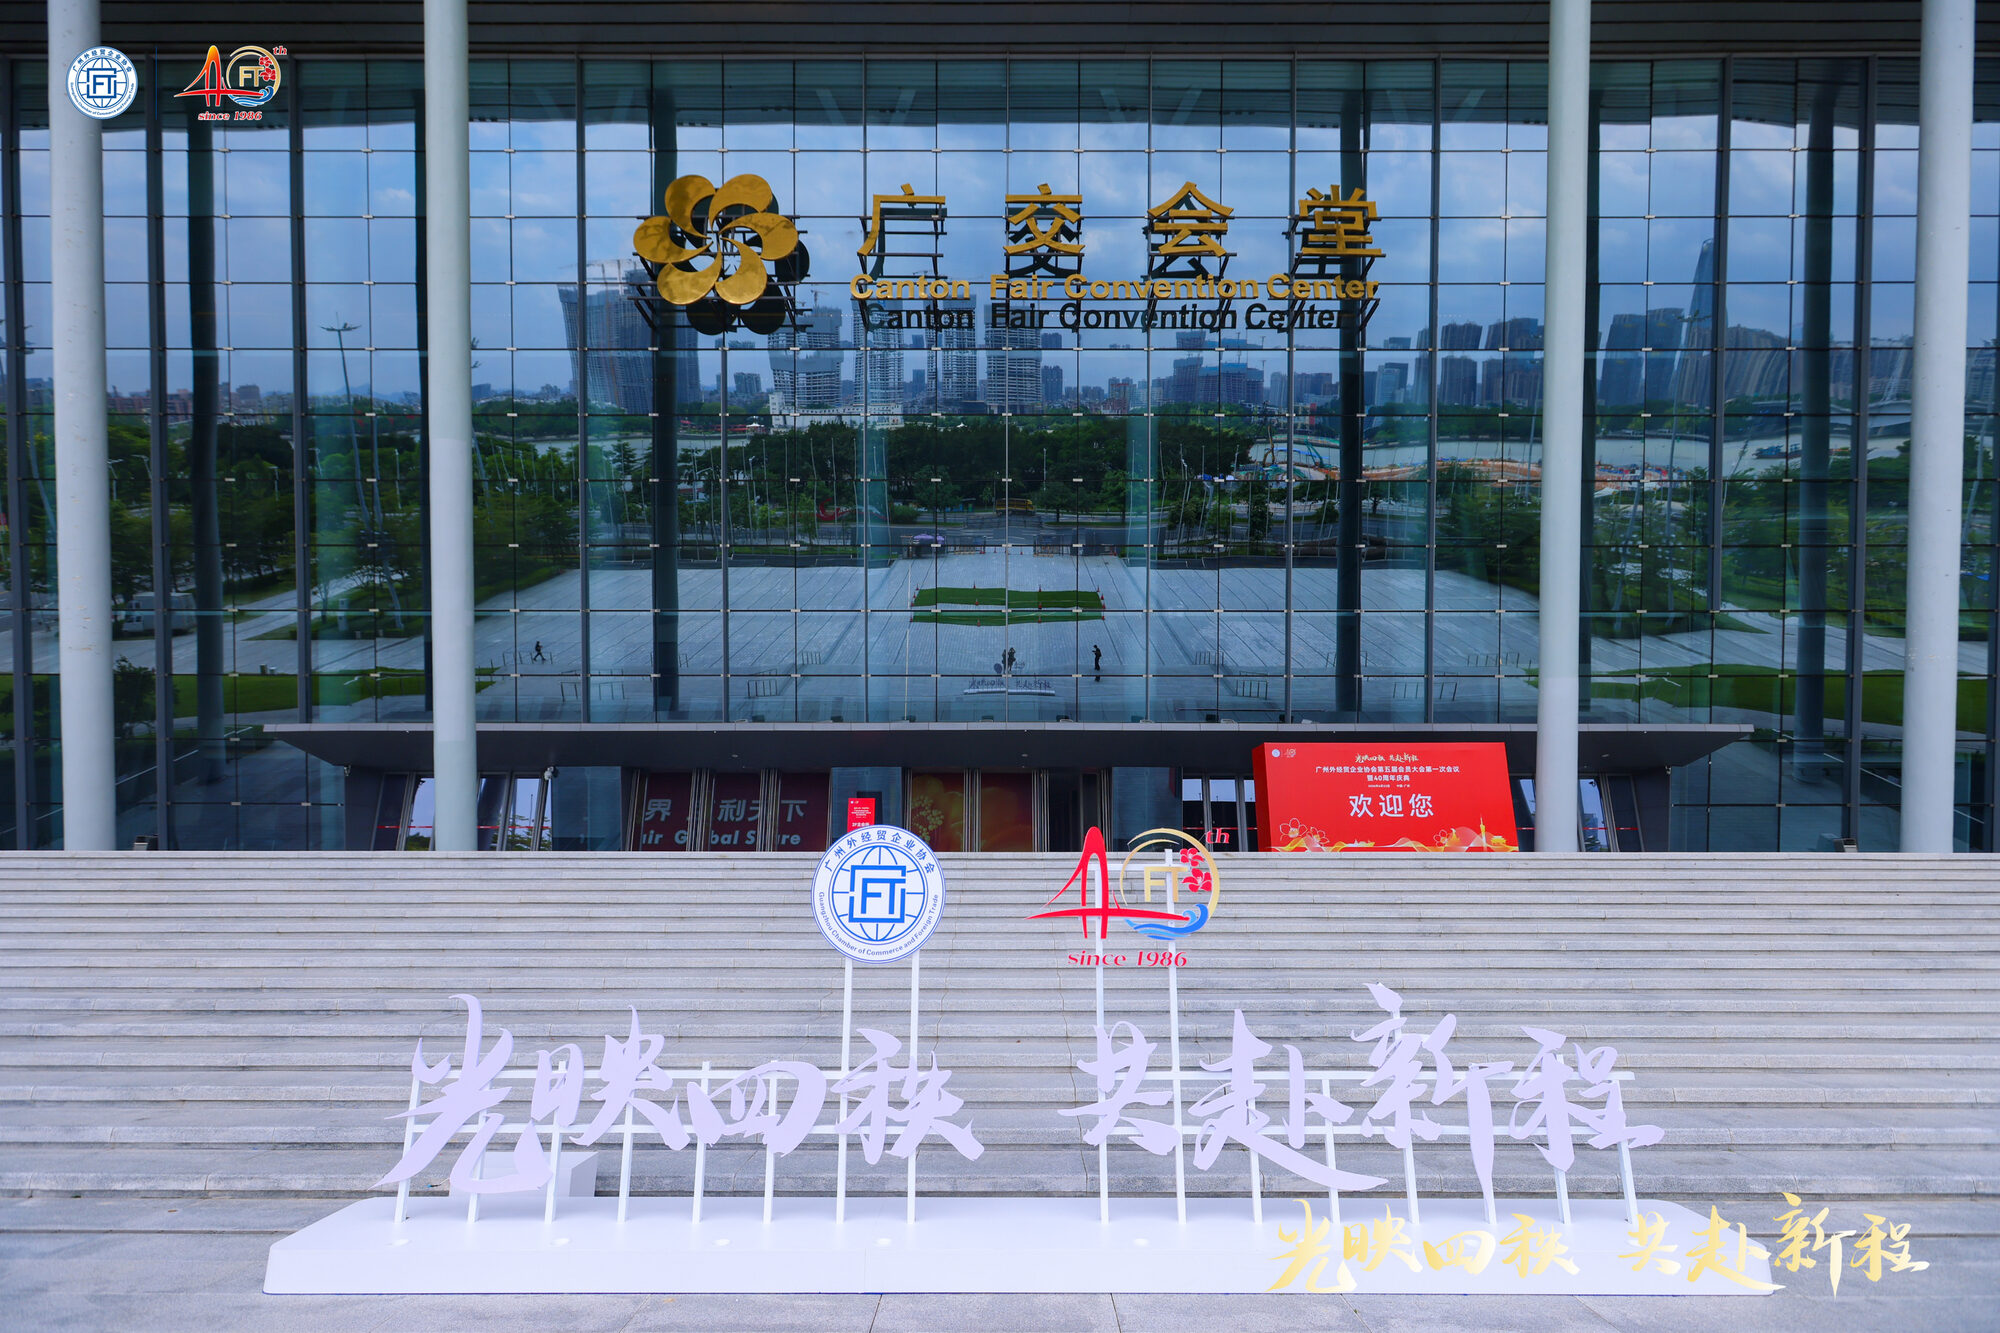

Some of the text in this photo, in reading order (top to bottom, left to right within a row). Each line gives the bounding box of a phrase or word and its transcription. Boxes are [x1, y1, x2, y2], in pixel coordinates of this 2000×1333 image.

[857, 181, 1382, 257] 广交会堂
[850, 274, 1379, 299] Canton Fair Convention Center
[866, 303, 973, 328] Canton
[991, 303, 1049, 328] Fair
[1060, 303, 1237, 328] Convention
[1349, 793, 1434, 818] 欢迎您
[674, 830, 740, 845] Gbal
[824, 830, 935, 874] 广州外经贸企业协会
[819, 891, 939, 956] Guangzhou Chamber of Commerce and Foreign Trade
[1068, 950, 1187, 967] since 1986
[1057, 982, 1665, 1200] 共赴新程
